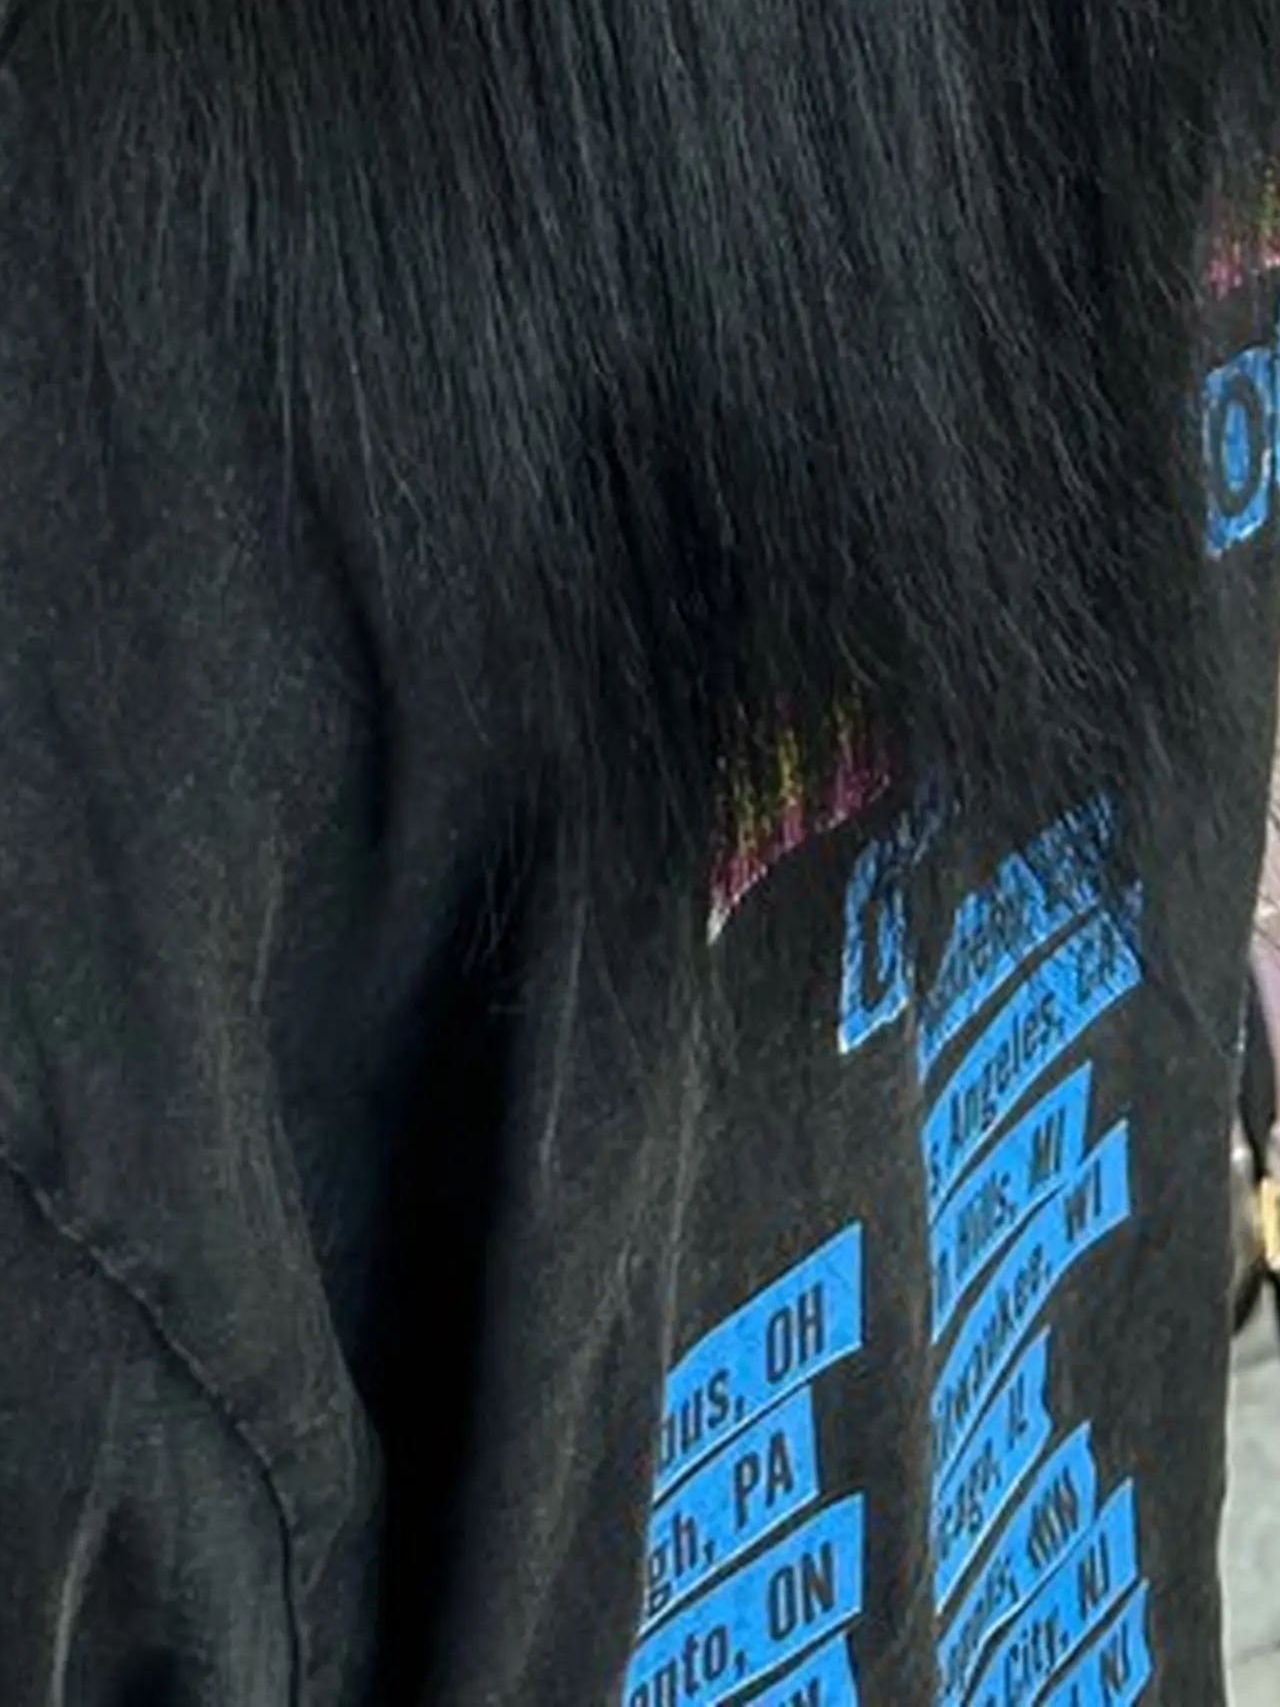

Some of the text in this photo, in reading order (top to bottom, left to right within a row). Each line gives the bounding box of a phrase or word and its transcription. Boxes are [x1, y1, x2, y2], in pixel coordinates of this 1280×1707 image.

[766, 1285, 827, 1387] OH
[734, 1429, 794, 1531] PA
[768, 1539, 834, 1643] ON
